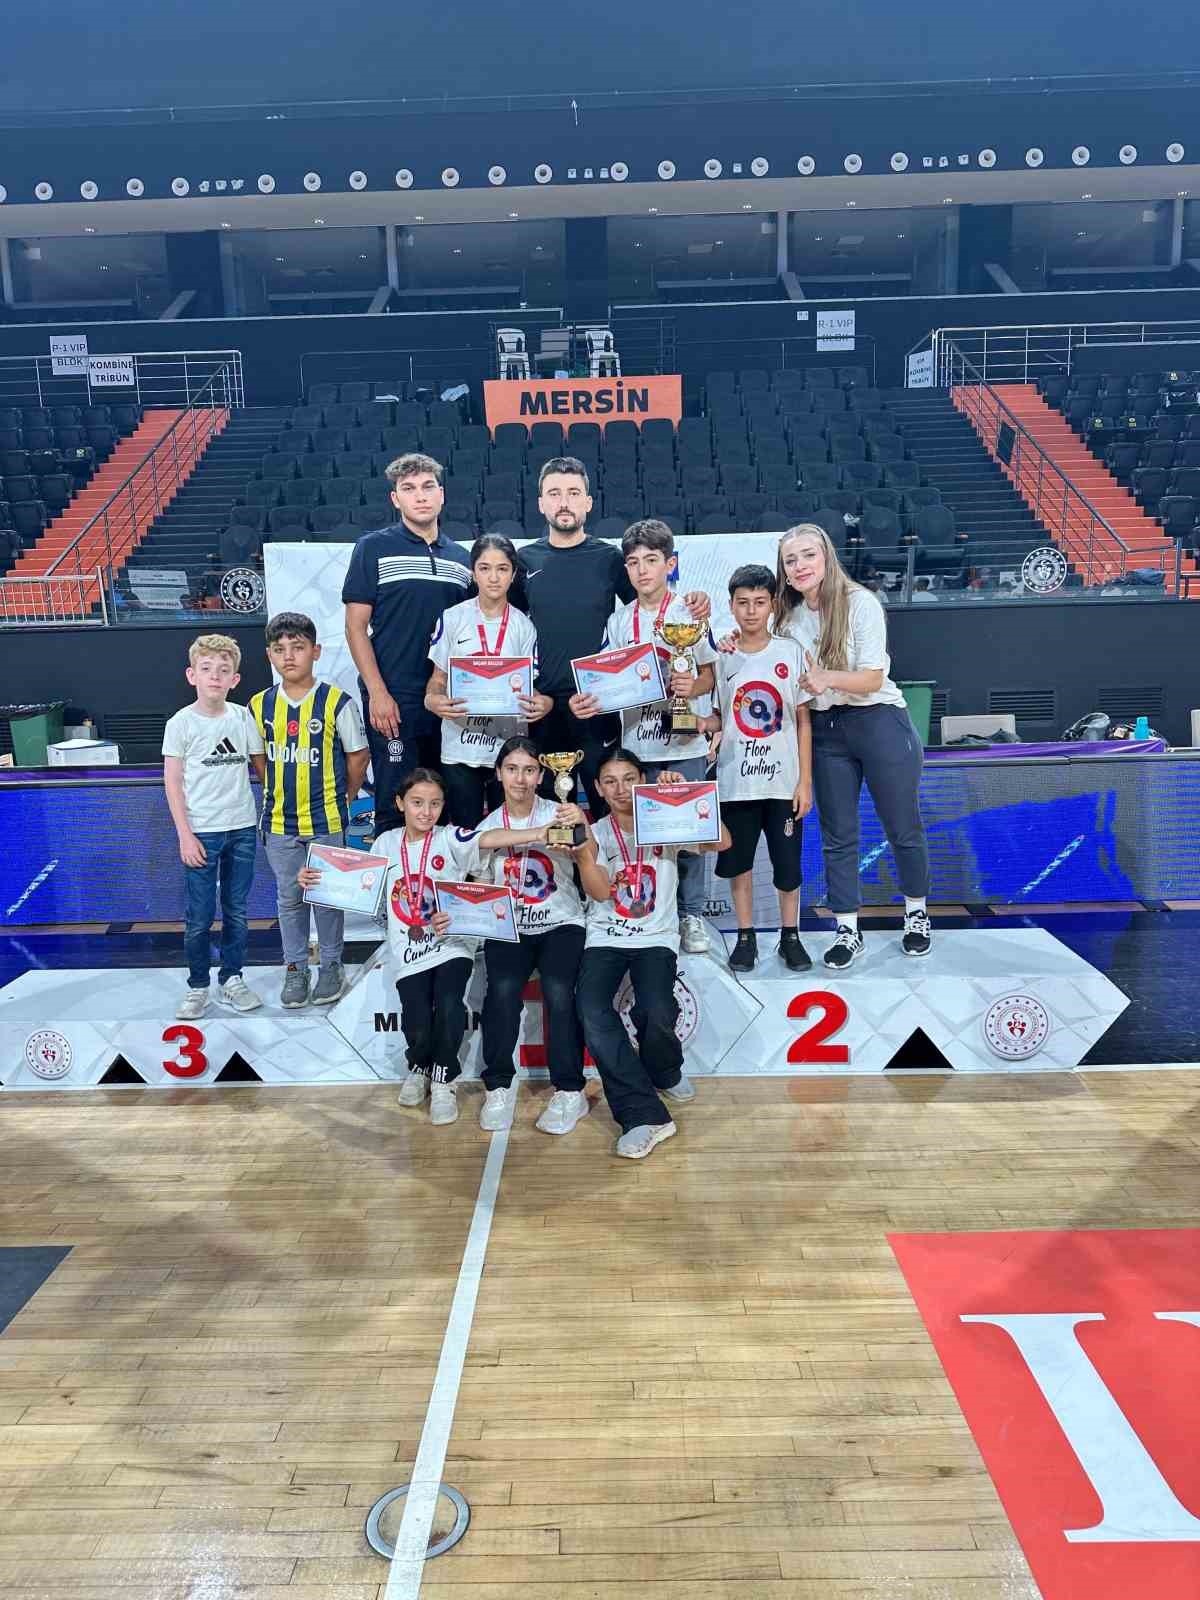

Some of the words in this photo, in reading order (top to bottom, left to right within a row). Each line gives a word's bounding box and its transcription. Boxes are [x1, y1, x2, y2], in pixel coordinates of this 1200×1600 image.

[69, 343, 86, 352] VIP
[90, 358, 134, 369] KOMBİNE
[95, 372, 130, 382] TRİBÜN
[519, 380, 649, 416] MERSİN
[460, 727, 497, 753] Curling
[637, 721, 672, 746] Curling
[744, 739, 771, 758] Floor
[740, 758, 777, 781] Curling
[520, 905, 551, 924] Floor
[786, 990, 849, 1064] 2
[162, 1025, 208, 1077] 3
